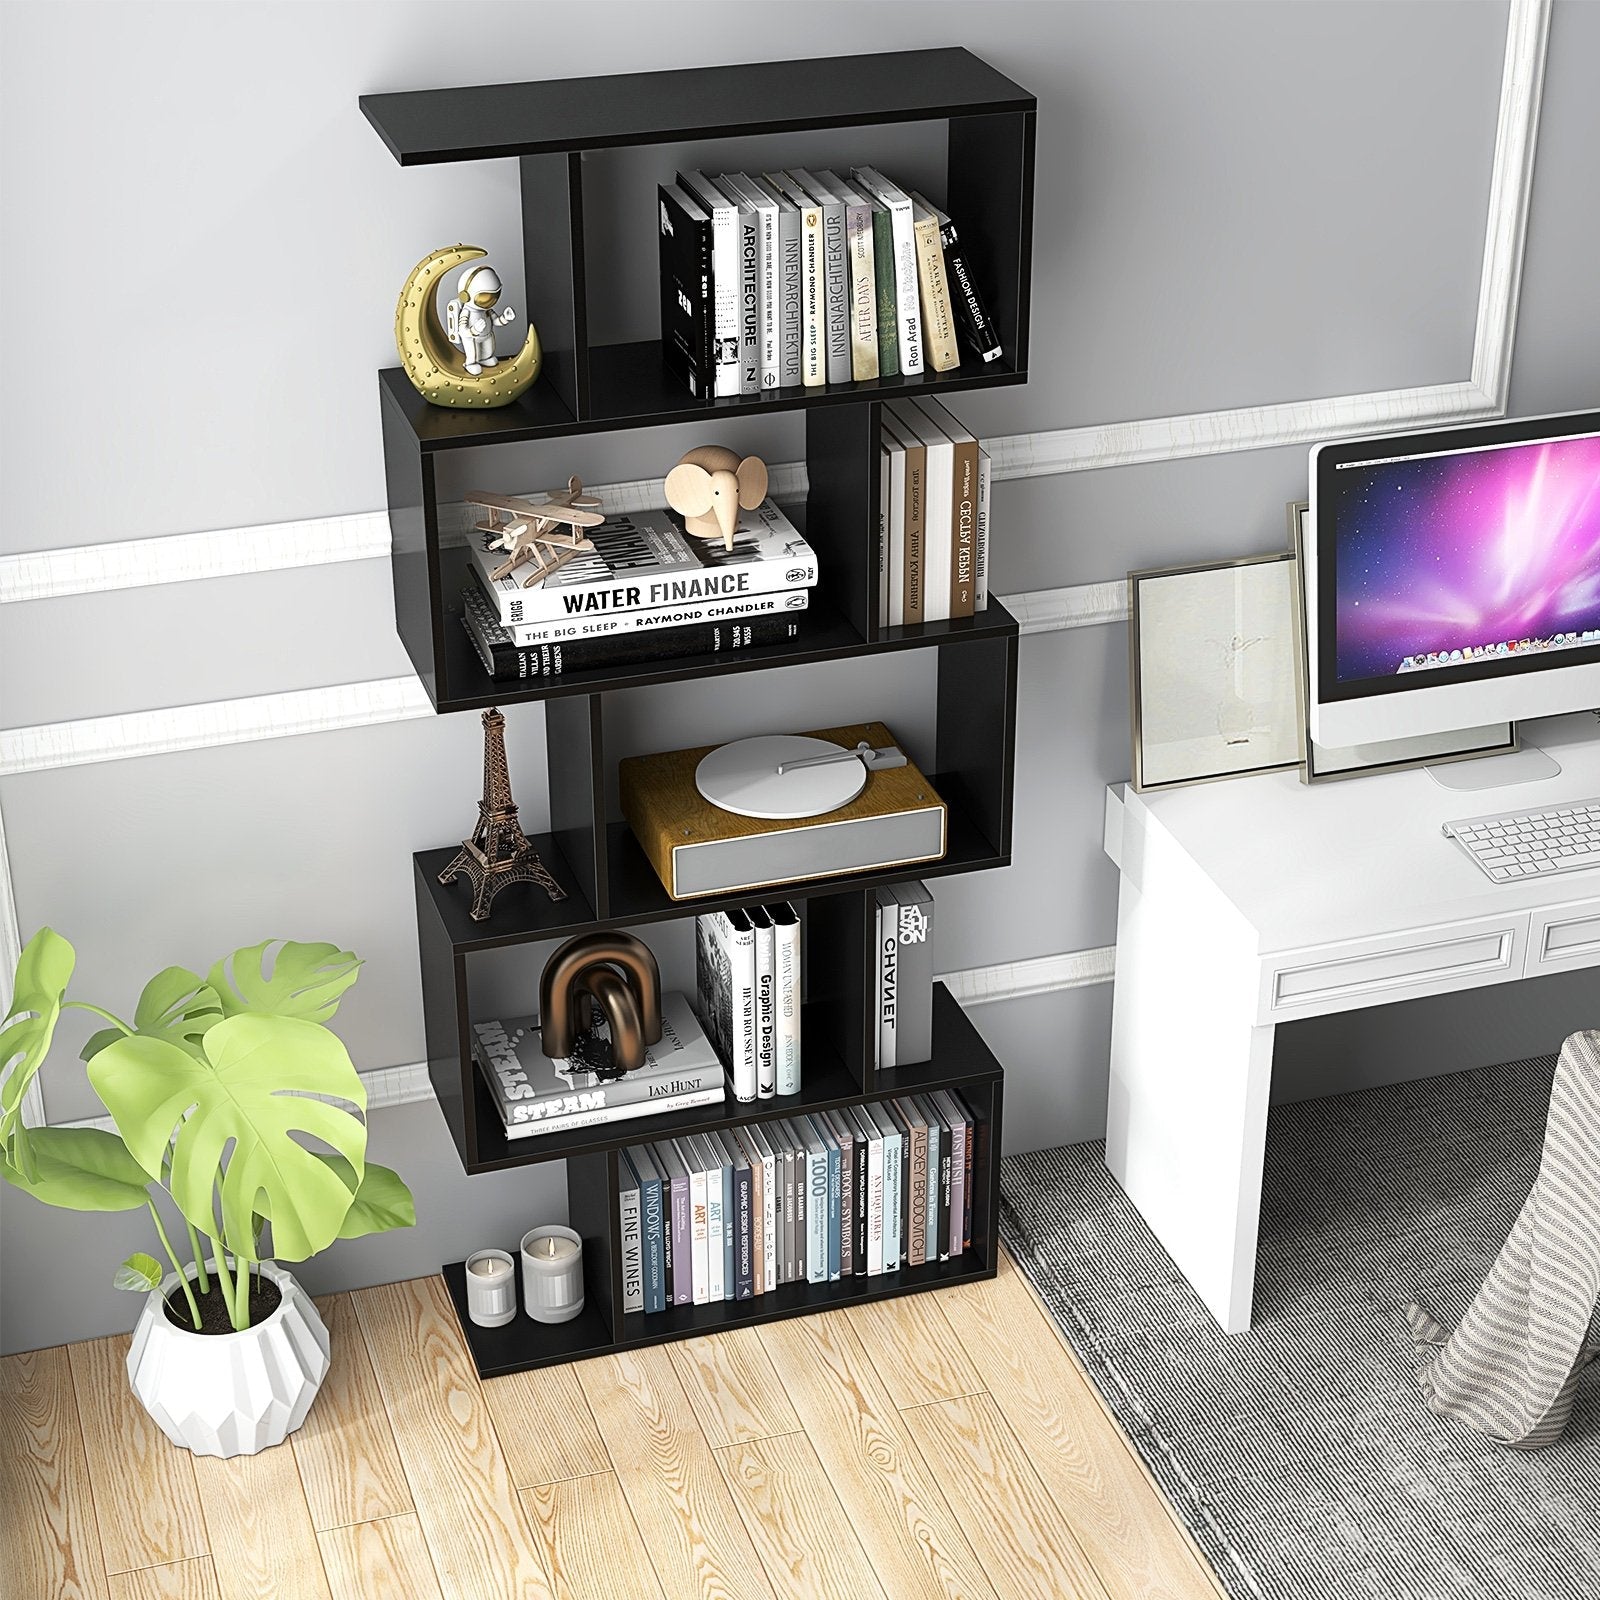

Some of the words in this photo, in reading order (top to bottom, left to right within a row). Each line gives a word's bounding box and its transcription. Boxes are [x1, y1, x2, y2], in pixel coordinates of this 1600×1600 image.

[744, 225, 757, 347] ARCHITECTURE
[827, 215, 846, 358] INNENARCHITEKTUR
[857, 276, 870, 305] DAYS
[953, 258, 973, 296] FASHION
[967, 296, 986, 330] DESIGN
[785, 238, 799, 376] INNENARCHITEKTUR
[858, 307, 872, 342] AFTER
[906, 318, 917, 342] Arad
[909, 345, 919, 367] Ron
[510, 600, 523, 622] GRIGG
[563, 587, 640, 613] WATER
[650, 573, 750, 603] FINANCE
[525, 631, 549, 641] THE
[554, 627, 577, 638] BIG
[582, 622, 618, 634] SLEEP
[636, 611, 703, 627] RAYMOND
[707, 601, 775, 617] CHANDLER
[760, 934, 772, 971] Swiss
[782, 943, 792, 974] WOMAN
[743, 987, 752, 1017] HENRI
[758, 975, 772, 1023] Graphic
[473, 1020, 536, 1101] STEAM
[743, 1019, 753, 1067] ROUSSEAU
[759, 1026, 773, 1067] Design
[648, 1085, 669, 1097] IAN
[671, 1078, 703, 1093] HUNT
[513, 1090, 606, 1123] STEAM
[914, 1131, 926, 1176] ALEXEY
[952, 1126, 964, 1157] LOST
[812, 1157, 827, 1197] 1000
[841, 1169, 852, 1199] BOOK
[928, 1168, 937, 1195] Gardens
[951, 1159, 964, 1186] FISH
[645, 1184, 660, 1240] WINDOWS
[710, 1202, 721, 1222] ART
[740, 1181, 748, 1210] GRAPHIC
[871, 1174, 882, 1242] ANTIQUAIRES
[624, 1207, 638, 1241] FINE
[694, 1205, 706, 1224] ART
[740, 1211, 749, 1234] DESIGN
[912, 1180, 926, 1258] BRODOVITCH
[928, 1203, 936, 1226] France
[841, 1208, 851, 1258] SYMBOLS
[625, 1246, 640, 1297] WINES
[741, 1234, 749, 1276] REFERENCED
